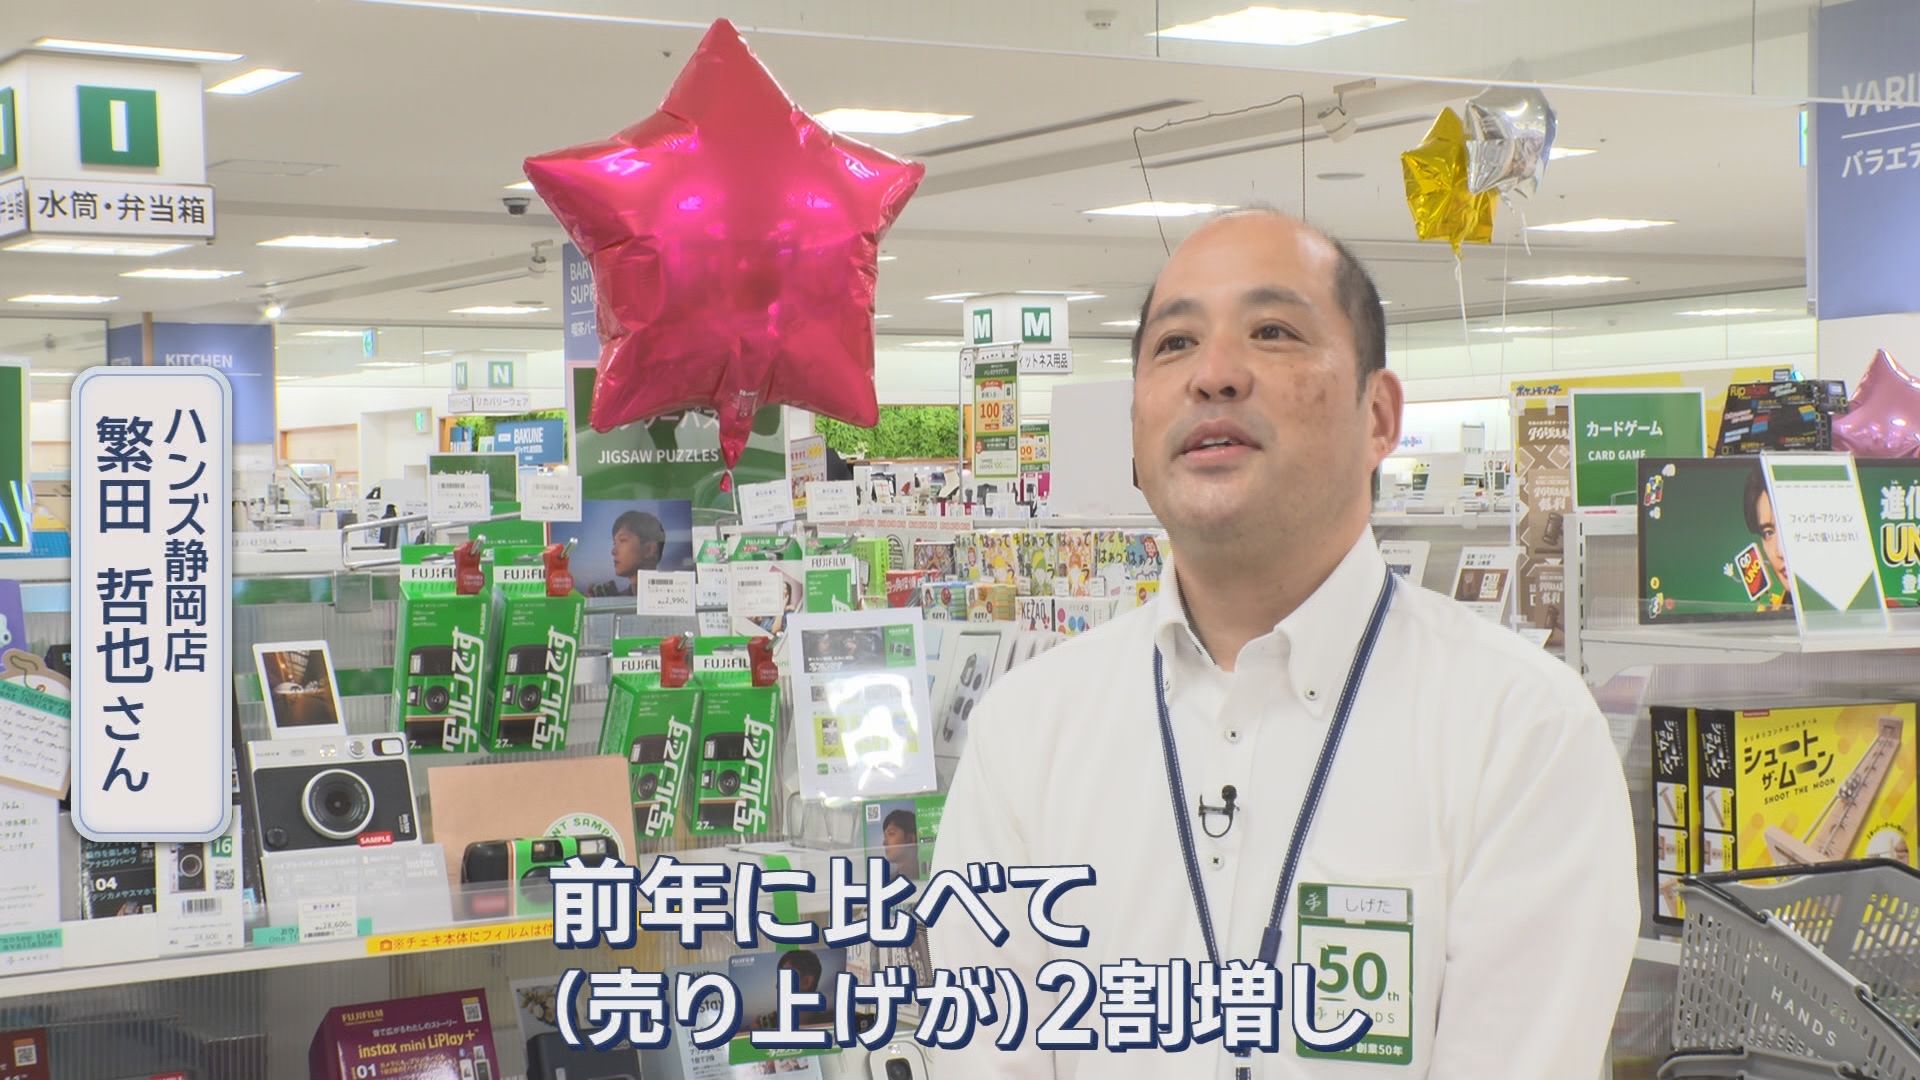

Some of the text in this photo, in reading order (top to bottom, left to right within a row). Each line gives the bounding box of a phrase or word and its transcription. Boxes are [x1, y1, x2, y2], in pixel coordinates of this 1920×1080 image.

[38, 190, 206, 224] 水筒・弁当箱
[974, 314, 990, 339] M
[1024, 312, 1050, 337] M
[165, 353, 233, 368] KITCHEN
[457, 365, 465, 384] N
[493, 365, 510, 385] N
[980, 402, 1000, 419] 100
[514, 427, 544, 444] BAKUNE
[1586, 420, 1663, 437] カードゲーム
[598, 447, 719, 464] JIGSAW PUZZLES
[1588, 450, 1615, 461] CARD
[811, 557, 847, 568] FUJIFILM
[1744, 729, 1819, 775] シュート
[1762, 751, 1834, 791] ザ・ムーン
[1764, 778, 1836, 805] SHOOT THE MOON
[214, 838, 232, 854] 16
[360, 835, 391, 845] SAMPLE
[95, 876, 118, 891] 04
[1345, 897, 1392, 914] しげた
[1317, 944, 1388, 1001] 50
[342, 1009, 384, 1023] FUJIFILM
[1336, 1009, 1395, 1023] HDS
[1770, 986, 1838, 1047] HANDS
[358, 1029, 475, 1058] instax mini LiPlay+
[1356, 1042, 1403, 1056] 創業50年
[356, 1063, 377, 1079] 01
